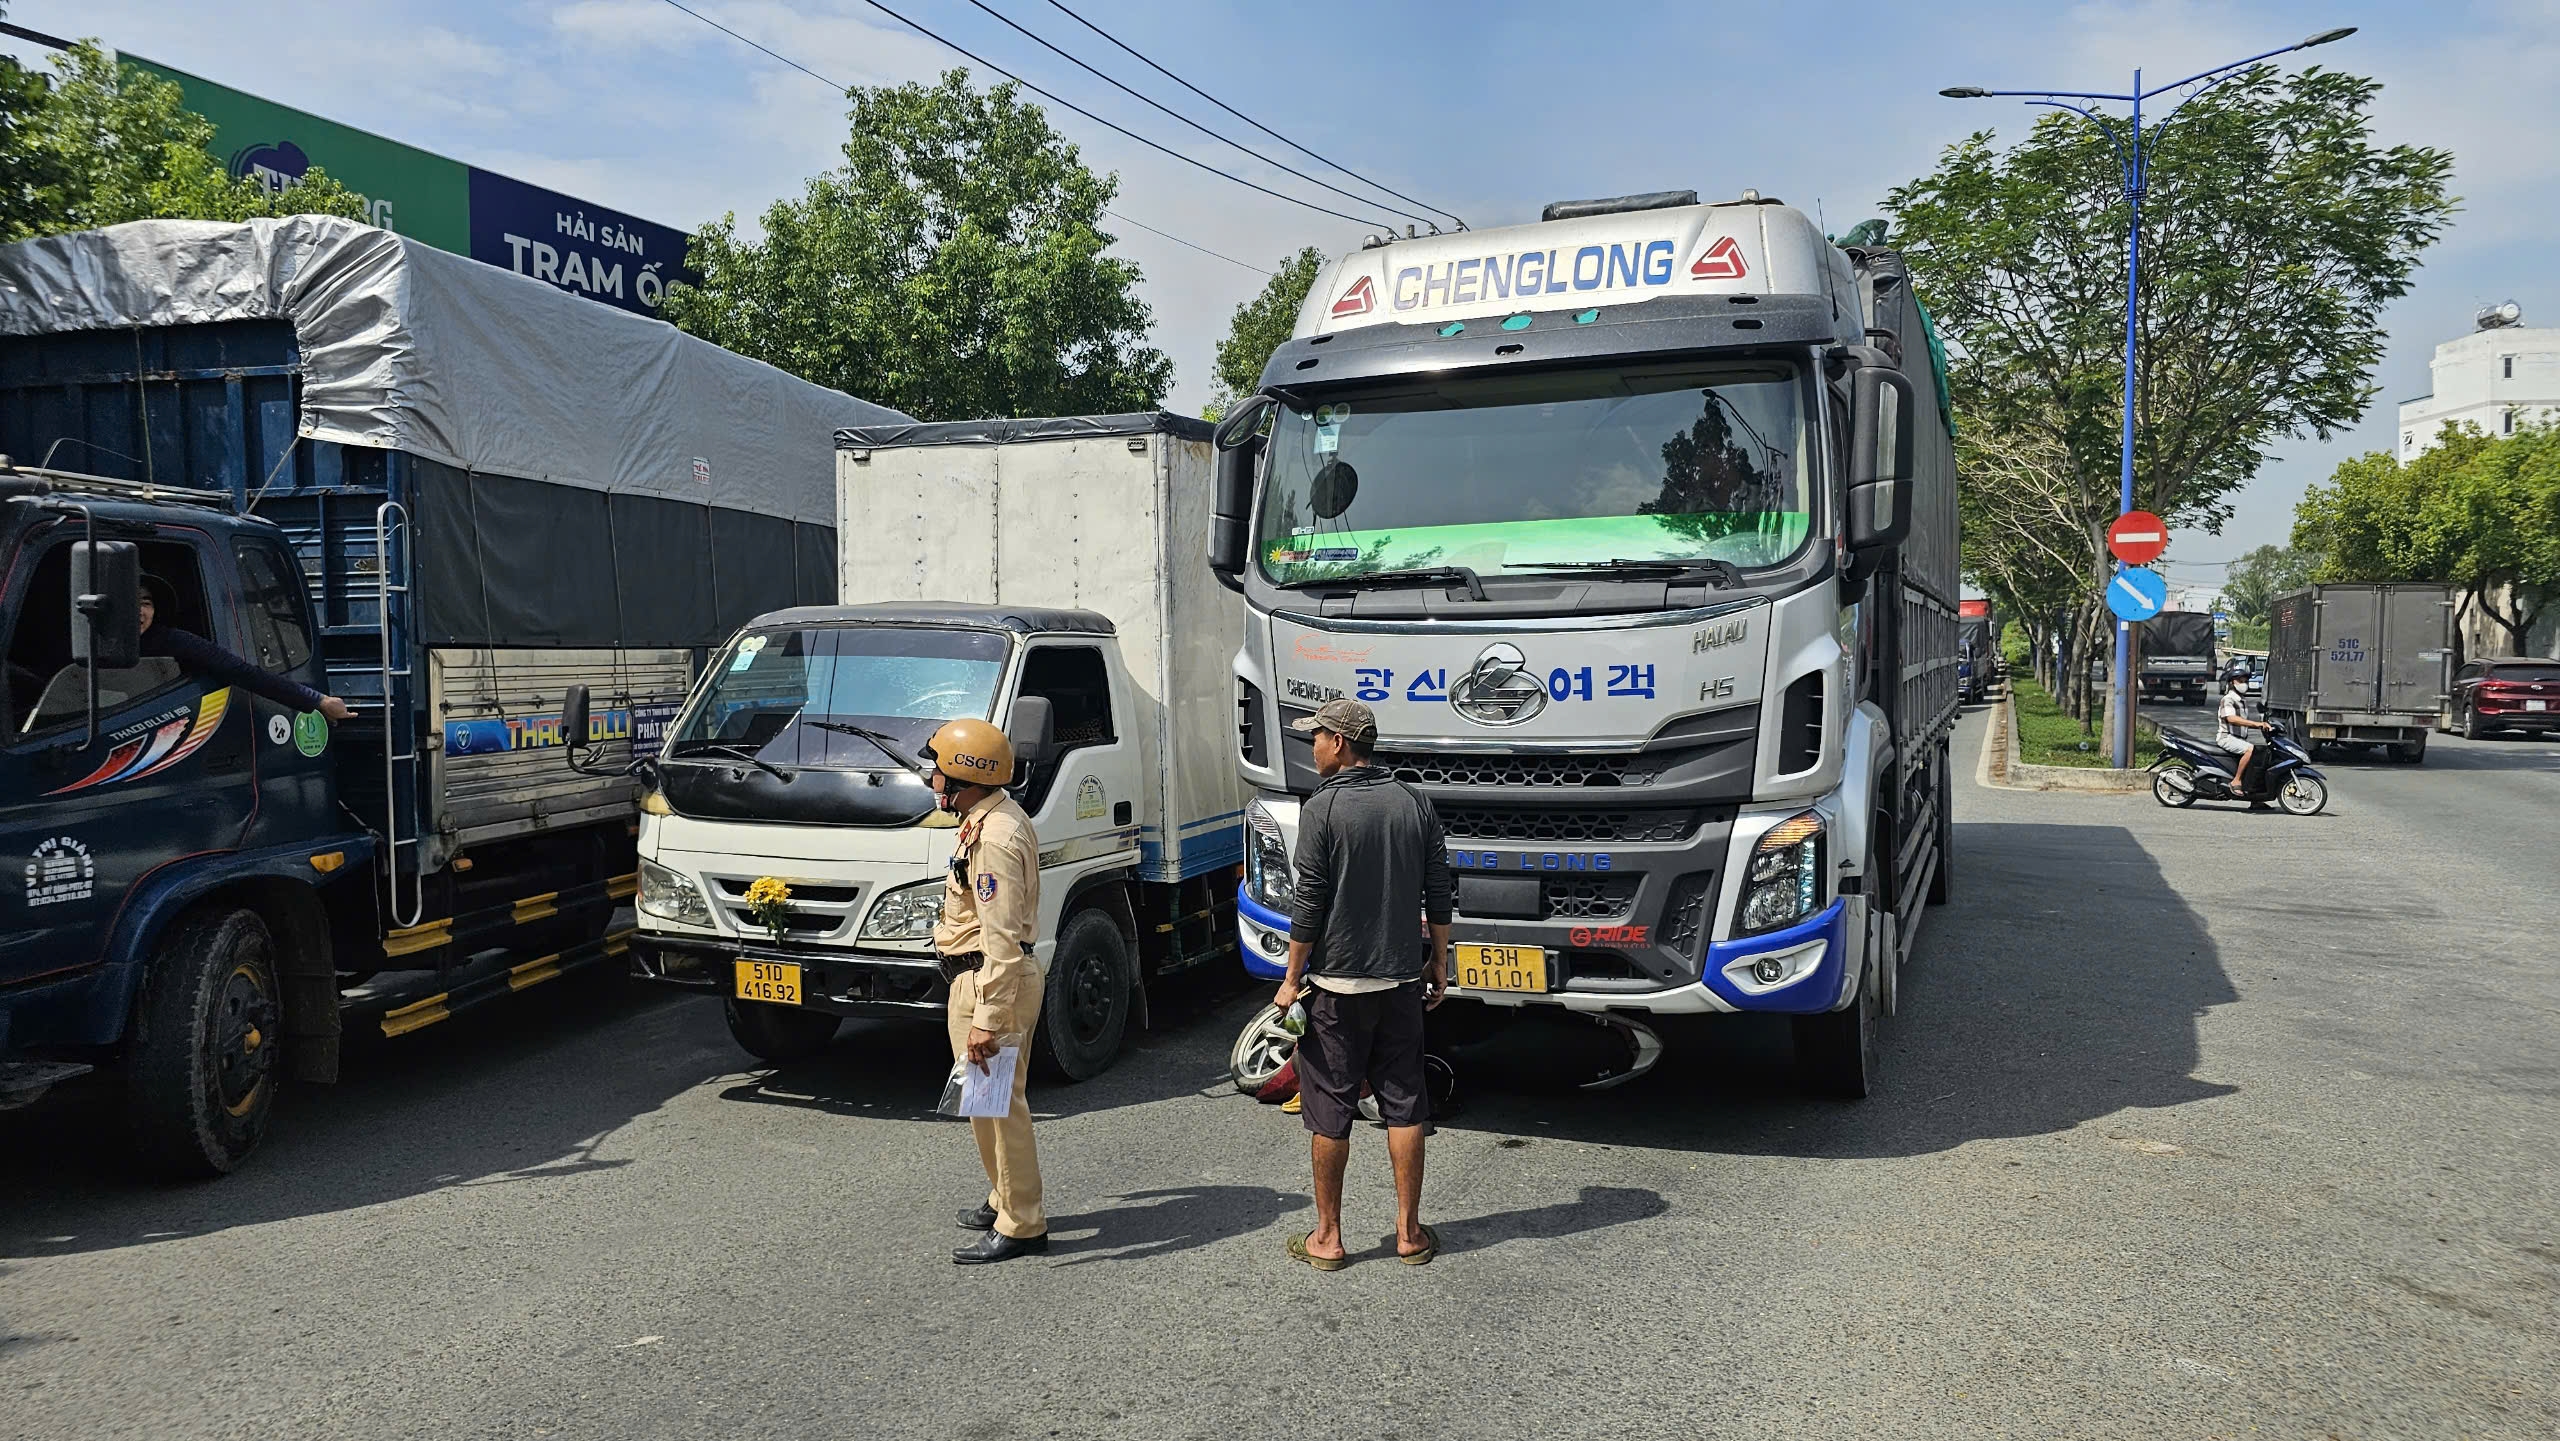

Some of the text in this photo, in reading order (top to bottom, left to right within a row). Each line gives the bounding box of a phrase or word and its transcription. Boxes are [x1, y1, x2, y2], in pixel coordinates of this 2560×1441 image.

[557, 211, 644, 256] HẢI SẢN
[504, 233, 624, 299] TRẠM
[1393, 240, 1675, 311] CHENGLONG
[2338, 639, 2359, 649] 51C
[2331, 651, 2364, 661] 521.77
[109, 723, 146, 742] THACO
[145, 712, 174, 730] OLLIN
[507, 718, 564, 749] THAC
[588, 712, 634, 742] OLLI
[637, 719, 660, 740] PHÁT
[954, 753, 999, 772] CSGT
[1520, 853, 1612, 871] LONG
[1594, 925, 1650, 942] RIDE
[1480, 948, 1519, 967] 63H
[753, 963, 783, 982] 51D
[1466, 968, 1534, 989] 011.01
[744, 981, 795, 1002] 416.92
